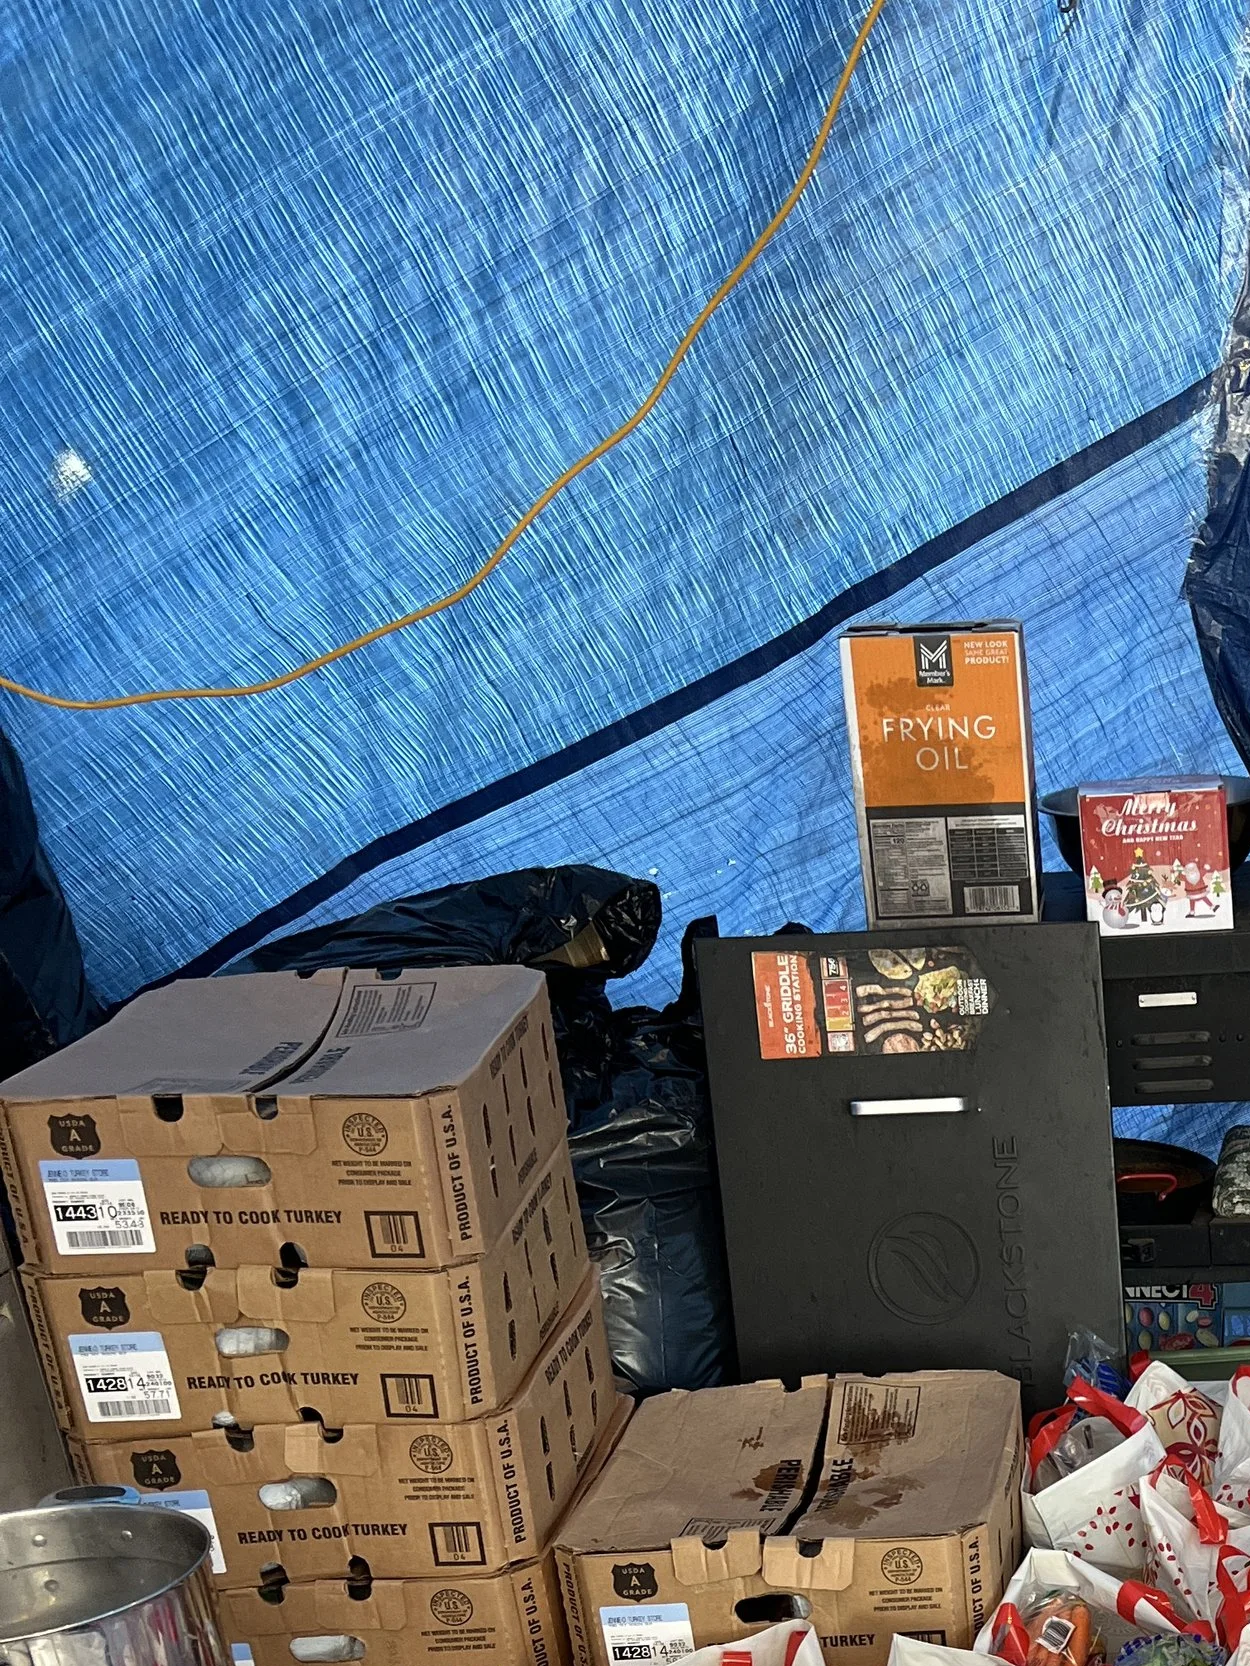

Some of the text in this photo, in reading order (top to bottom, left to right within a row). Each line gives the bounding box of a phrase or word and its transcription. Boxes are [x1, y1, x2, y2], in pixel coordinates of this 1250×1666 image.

[964, 640, 1008, 649] NEW LOOK
[964, 656, 1009, 665] PRODUCT!
[882, 715, 996, 742] FRYING
[916, 746, 968, 771] OIL
[1117, 798, 1177, 817] Merry
[1101, 818, 1198, 837] Christmas
[777, 955, 794, 1023] GRIDDLE
[980, 979, 988, 1015] DINNER
[789, 955, 806, 1054] COOKING STATION
[344, 1113, 385, 1133] INSPECTED
[69, 1129, 81, 1142] A
[357, 1127, 374, 1137] U.S.
[61, 1145, 94, 1153] GRADE
[441, 1105, 473, 1241] PRODUCT OF U.S.A.
[56, 1206, 98, 1220] 1443
[160, 1211, 208, 1225] READY
[213, 1210, 233, 1224] TO
[238, 1209, 280, 1224] COOK
[284, 1210, 342, 1223] TURKEY
[993, 1135, 1032, 1387] BLACKSTONE
[90, 1291, 116, 1299] USDA
[364, 1282, 403, 1302] INSPECTED
[99, 1301, 111, 1313] A
[376, 1296, 392, 1306] U.S.
[92, 1315, 124, 1323] GRADE
[458, 1275, 484, 1405] PRODUCT OF U.S.A.
[87, 1379, 127, 1392] 1428
[127, 1376, 146, 1391] 14
[187, 1371, 359, 1389] READY TO COOK TURKEY
[411, 1435, 450, 1454] INSPECTED
[424, 1447, 440, 1457] U.S.
[141, 1454, 166, 1462] USDA
[151, 1463, 163, 1475] A
[144, 1476, 175, 1485] GRADE
[497, 1418, 526, 1543] PRODUCT OF U.S.A.
[760, 1459, 802, 1512] PERISHABLE
[237, 1523, 407, 1544] READY TO COOK TURKEY
[883, 1548, 920, 1568] INSPECTED
[895, 1559, 910, 1568] U.S.
[968, 1536, 981, 1575] U.S.A.
[622, 1567, 645, 1575] USDA
[630, 1576, 641, 1587] A
[971, 1578, 982, 1597] OF
[432, 1589, 470, 1607] INSPECTED
[521, 1577, 538, 1616] U.S.A.
[622, 1588, 652, 1596] GRADE
[444, 1601, 459, 1610] U.S.
[562, 1563, 579, 1619] PRODUCT
[573, 1622, 582, 1638] OF
[528, 1619, 542, 1635] OF
[821, 1634, 875, 1648] TURKEY
[614, 1646, 668, 1659] 1428 14
